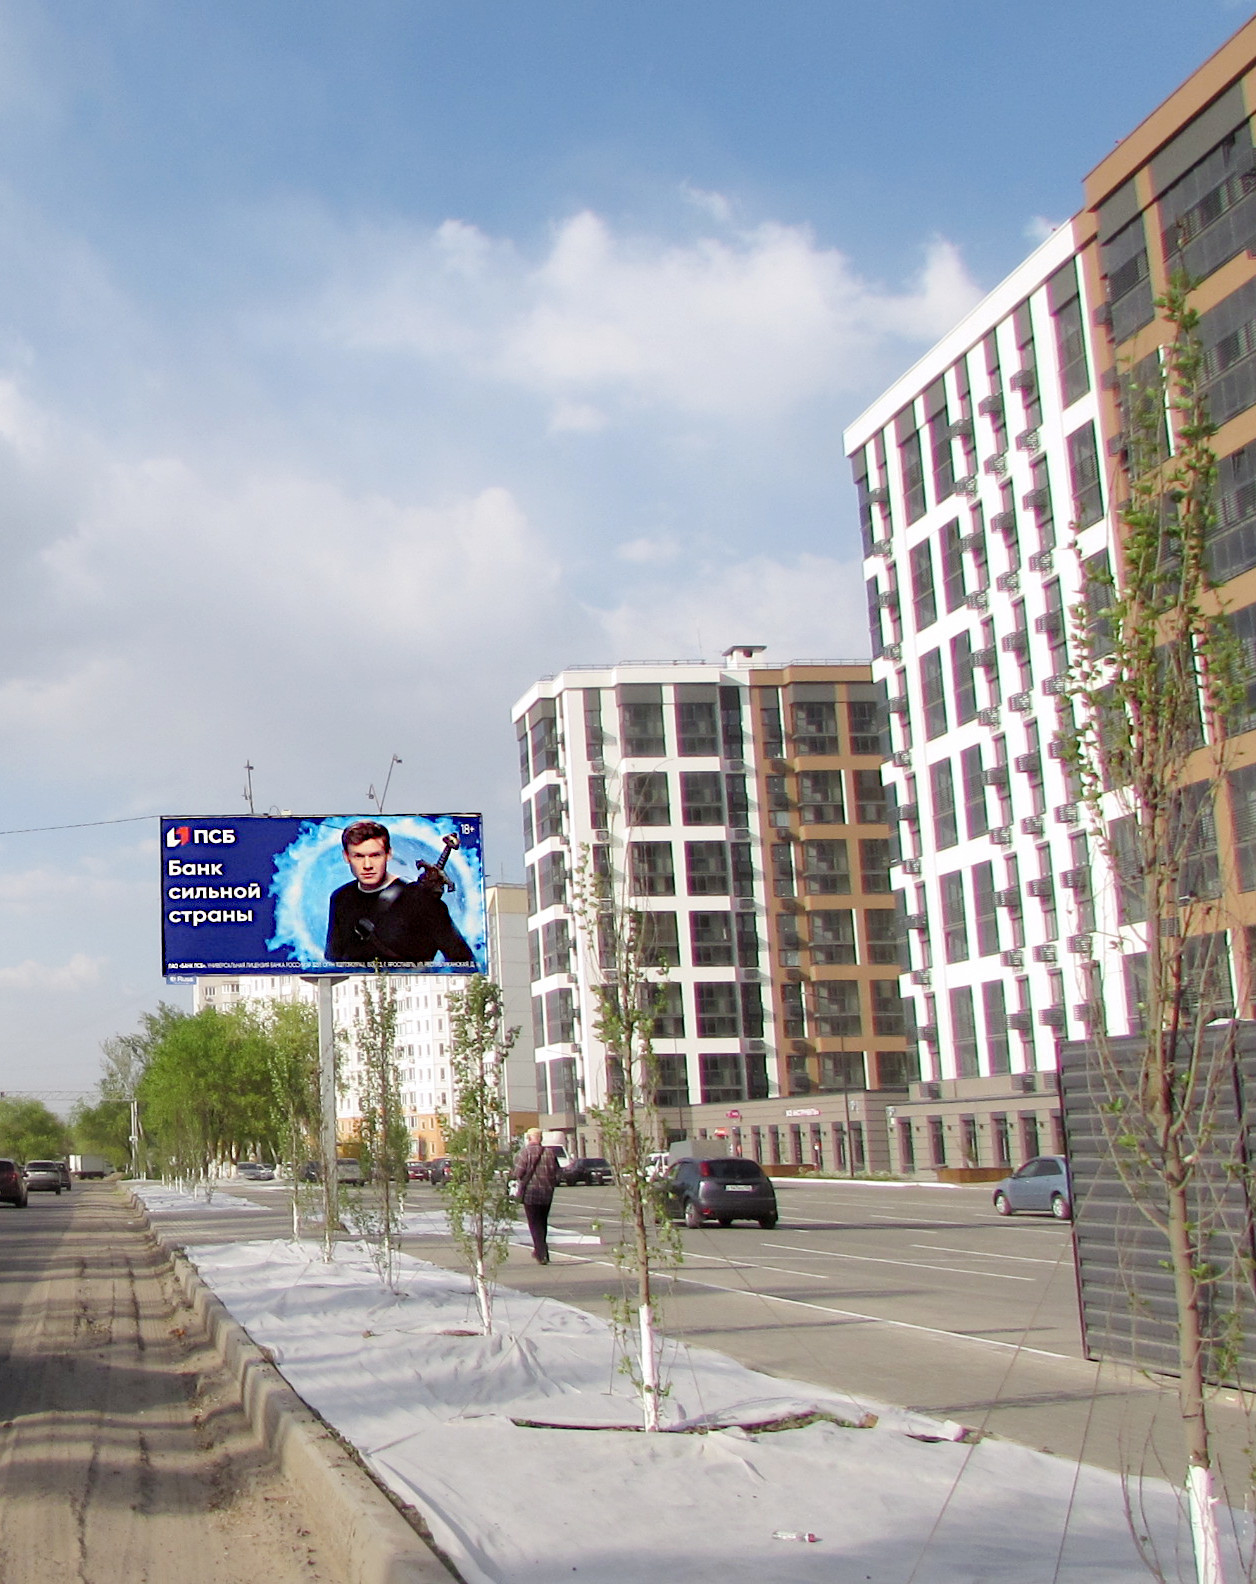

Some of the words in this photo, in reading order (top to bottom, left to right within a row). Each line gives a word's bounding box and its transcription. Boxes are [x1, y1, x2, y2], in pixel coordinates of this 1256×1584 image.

[194, 829, 236, 844] ПСБ
[460, 823, 475, 834] 18+
[168, 860, 223, 876] Банк
[168, 883, 261, 899] сильной
[168, 910, 253, 926] страны
